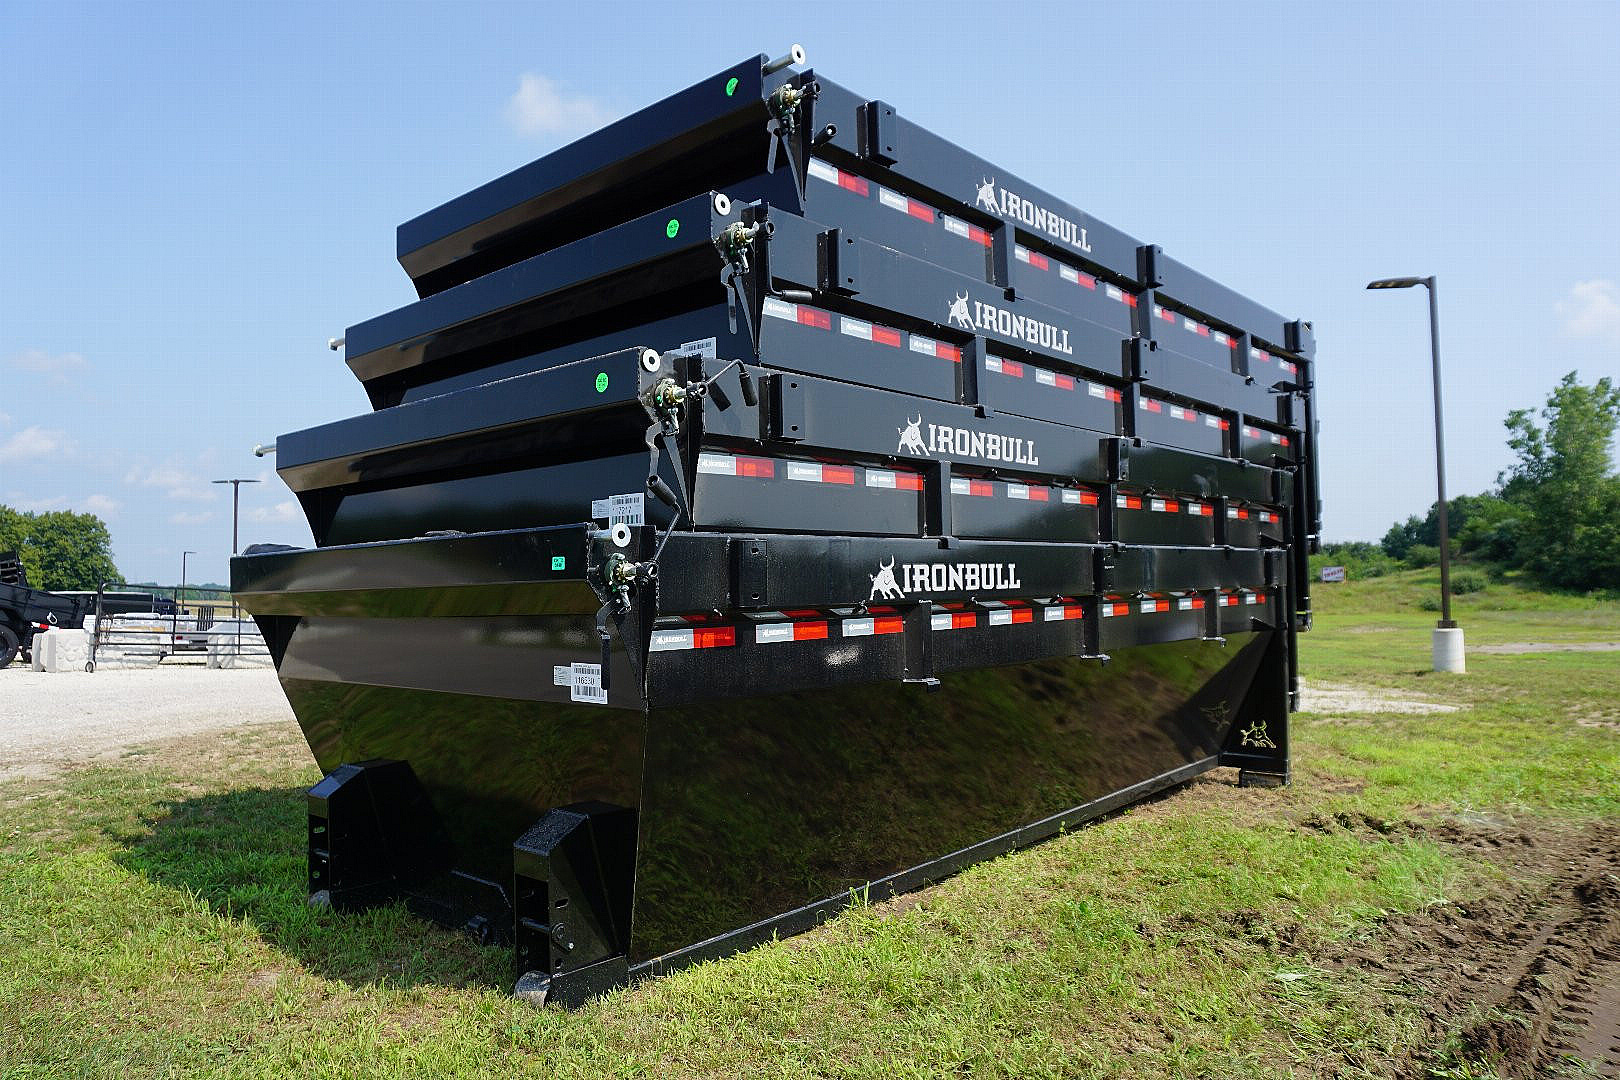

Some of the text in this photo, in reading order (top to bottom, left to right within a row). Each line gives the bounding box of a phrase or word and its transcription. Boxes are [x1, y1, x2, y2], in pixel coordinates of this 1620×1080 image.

[999, 187, 1092, 253] IRONBULL
[974, 300, 1073, 355] IRONBULL
[928, 423, 1039, 466] IRONBULL
[902, 563, 1021, 593] IRONBULL
